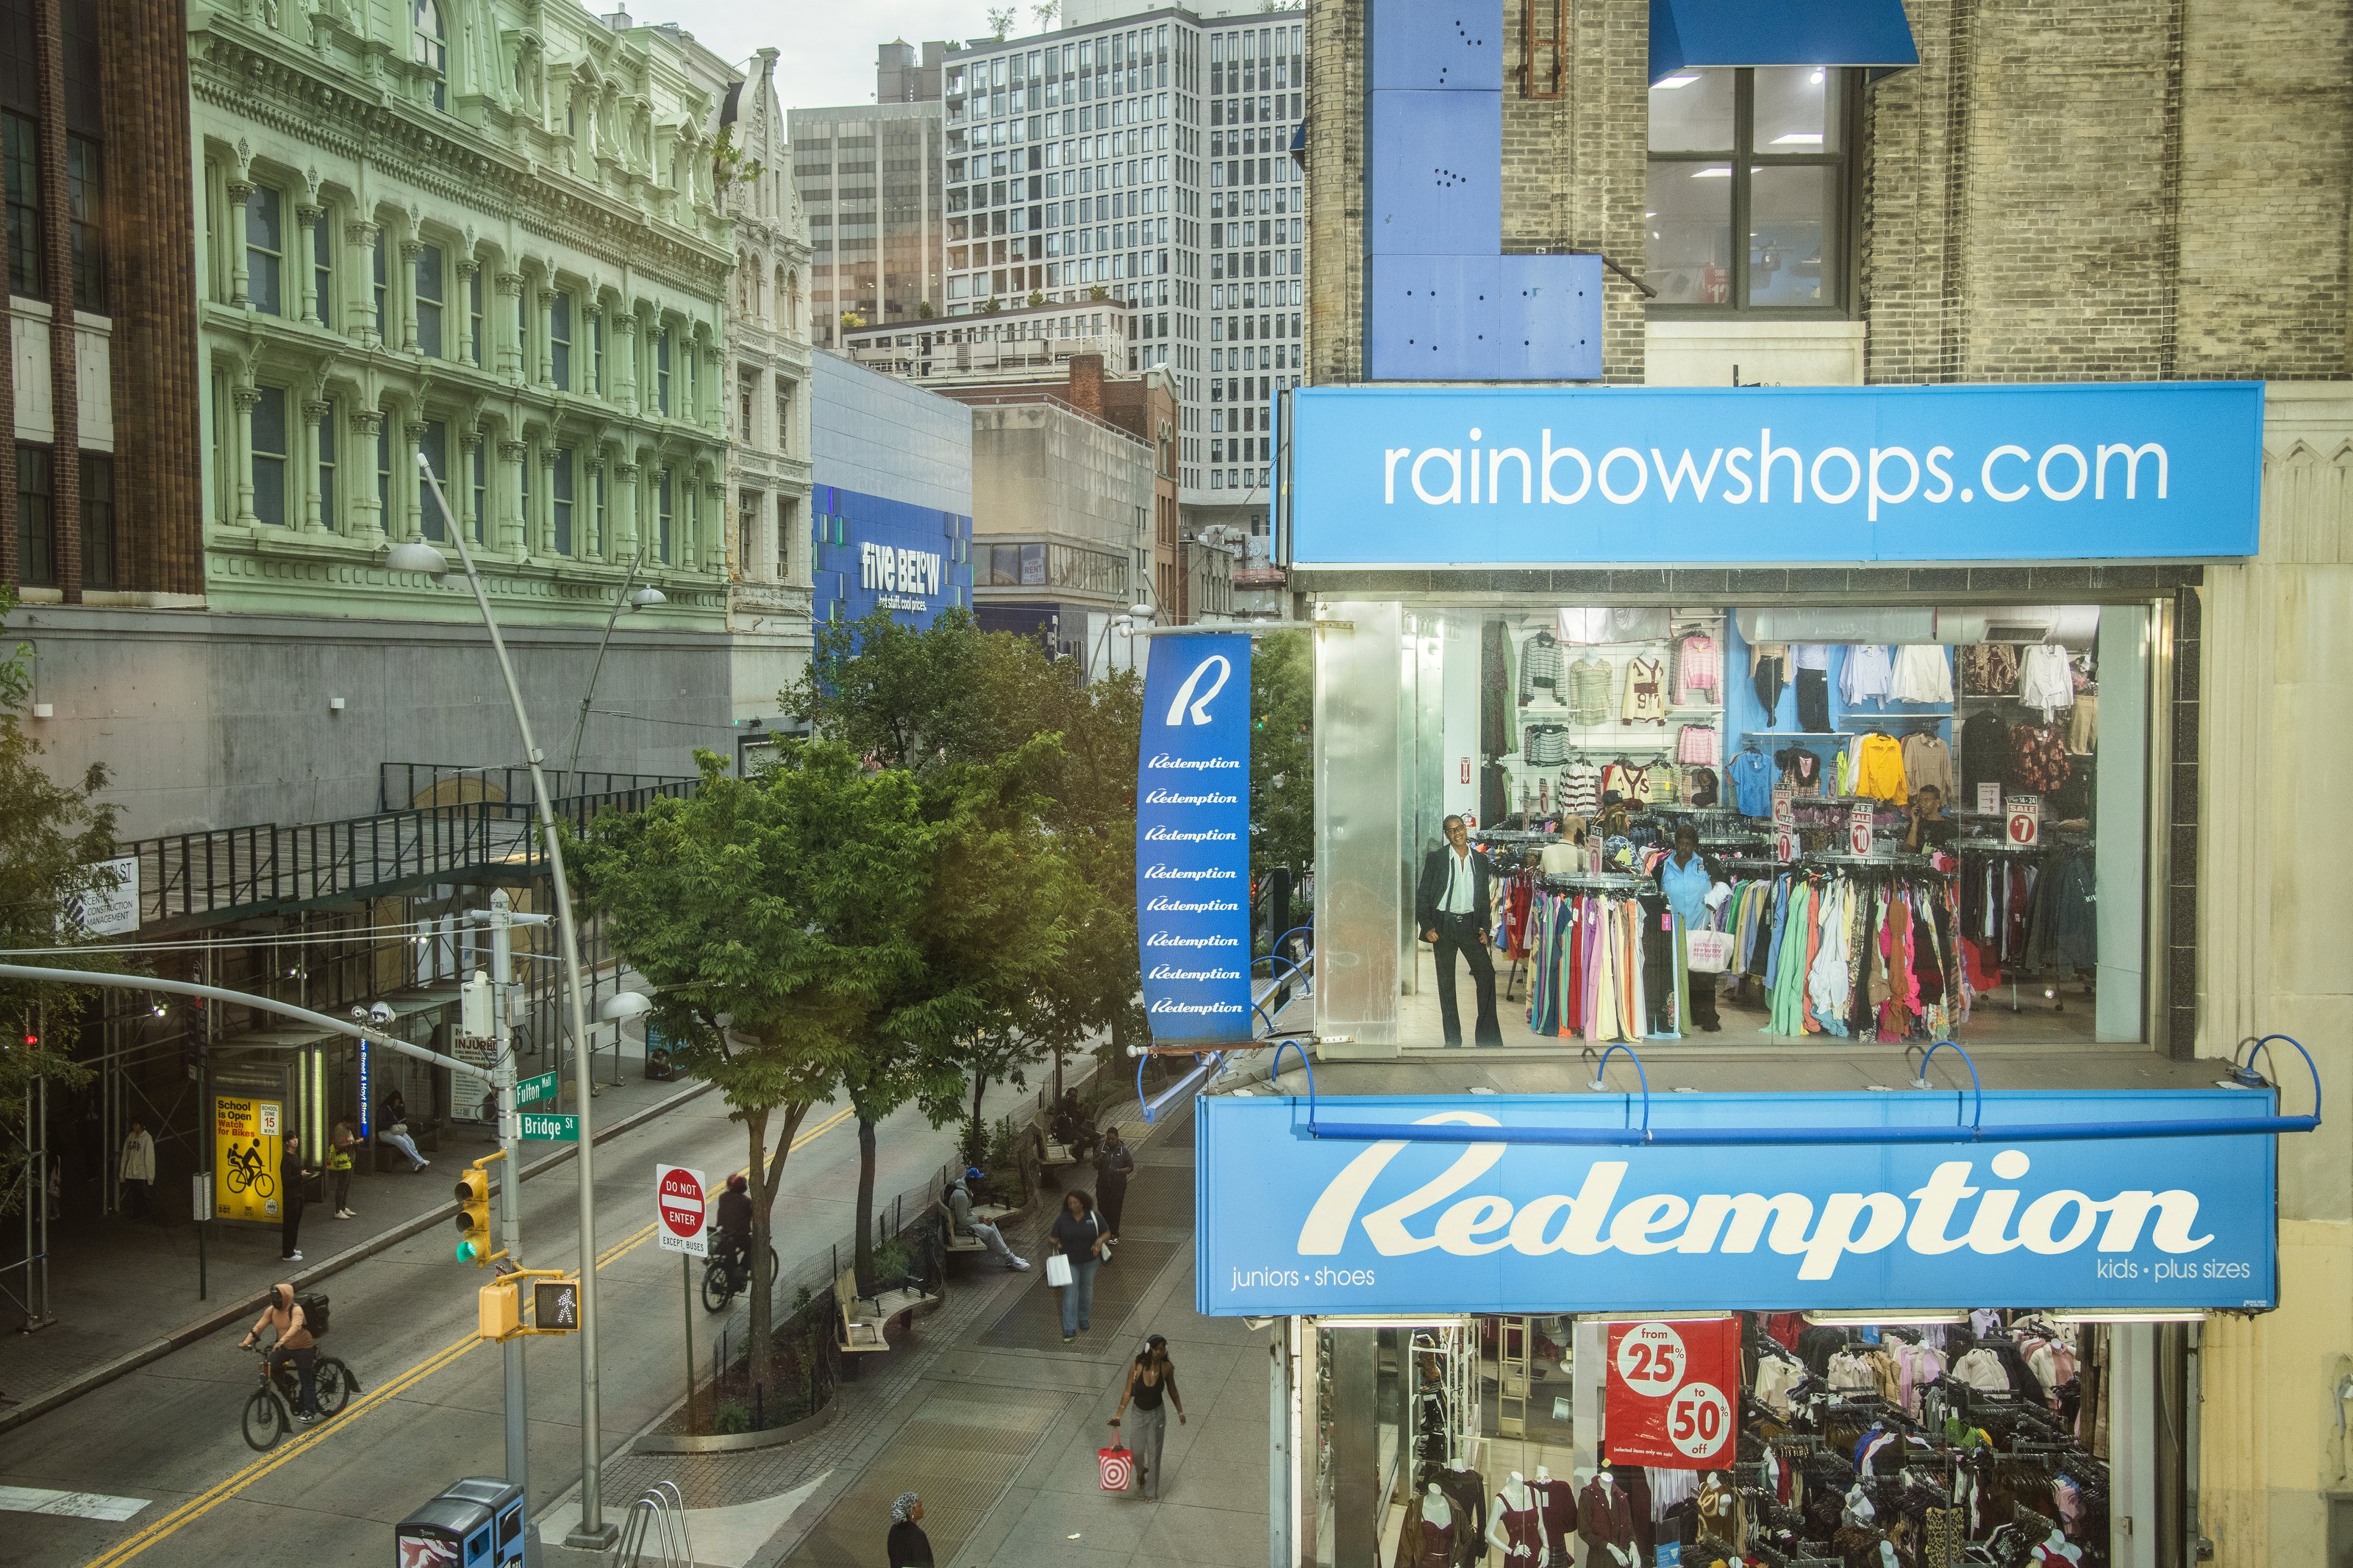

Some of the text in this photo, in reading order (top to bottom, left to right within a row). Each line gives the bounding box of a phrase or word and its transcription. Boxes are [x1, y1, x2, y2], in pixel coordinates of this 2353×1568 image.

[1385, 427, 2168, 522] rainbowshops.com
[862, 541, 896, 592] five
[1024, 565, 1043, 574] RENT
[901, 596, 912, 610] cool
[1166, 655, 1231, 726] R
[1149, 753, 1240, 772] Redemption
[1146, 788, 1238, 806] Redemption
[1852, 814, 1870, 823] SALE
[1145, 825, 1237, 844] Redemption
[1779, 824, 1791, 833] SALE
[1145, 863, 1237, 882] Redemption
[88, 894, 114, 906] CENTRAL
[1147, 895, 1239, 914] Redemption
[88, 901, 133, 916] CONSTRUCTION
[88, 912, 129, 926] MANAGEMENT
[1147, 931, 1239, 950] Redemption
[1149, 964, 1240, 983] Redemption
[1151, 997, 1243, 1016] Redemption
[517, 1075, 551, 1104] Fulton Mall
[218, 1100, 251, 1111] School
[218, 1110, 251, 1121] is Open
[265, 1117, 275, 1128] 15
[218, 1120, 243, 1128] Watch
[525, 1117, 573, 1140] Bridge St
[218, 1127, 255, 1137] for Bikes
[666, 1181, 696, 1195] DO NOT
[1297, 1111, 2215, 1280] Redemption
[669, 1211, 696, 1226] ENTER
[663, 1236, 704, 1252] EXCEPT BUSES
[1231, 1264, 1375, 1292] juniors shoes
[2097, 1258, 2251, 1283] kids plus sizes
[1641, 1328, 1668, 1339] from
[1694, 1388, 1705, 1397] to
[1692, 1444, 1707, 1454] off
